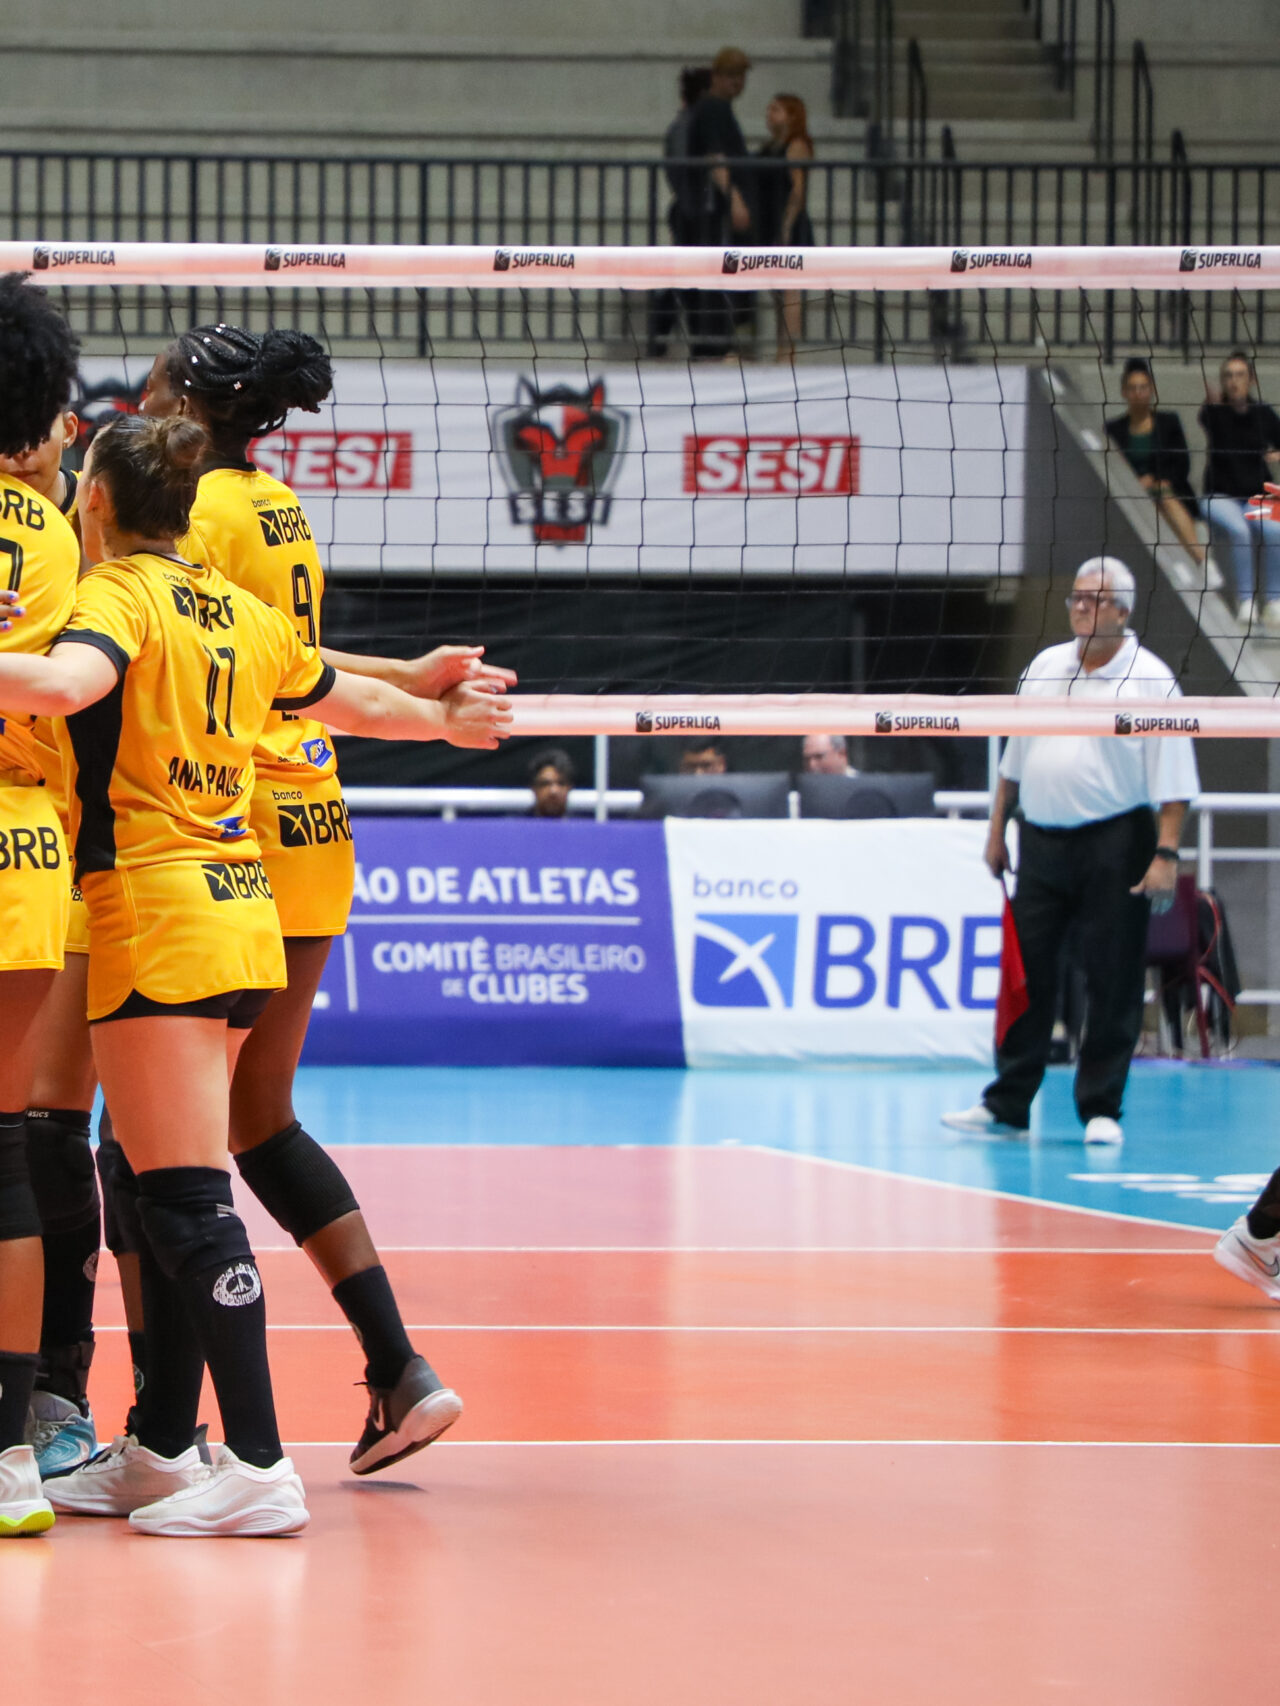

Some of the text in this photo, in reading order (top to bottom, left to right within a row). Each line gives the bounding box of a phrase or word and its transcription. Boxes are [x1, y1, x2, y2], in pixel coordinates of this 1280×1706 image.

[52, 250, 116, 267] SUPERLIGA
[283, 252, 346, 269] SUPERLIGA
[512, 253, 575, 269] SUPERLIGA
[740, 254, 804, 271] SUPERLIGA
[969, 253, 1032, 269] SUPERLIGA
[1198, 253, 1261, 269] SUPERLIGA
[253, 435, 398, 486] SESI
[696, 439, 847, 491] SESI
[277, 505, 312, 544] BRB
[291, 563, 317, 650] 9
[655, 715, 720, 731] SUPERLIGA
[894, 716, 960, 732] SUPERLIGA
[1134, 717, 1200, 733] SUPERLIGA
[168, 756, 203, 793] ANA
[272, 790, 303, 801] banco
[406, 866, 462, 904] DE
[467, 866, 640, 906] ATLETAS
[693, 872, 799, 899] banco
[371, 936, 646, 974] COMITÊ BRASILEIRO
[812, 913, 1002, 1011] BRB
[467, 972, 589, 1005] CLUBES
